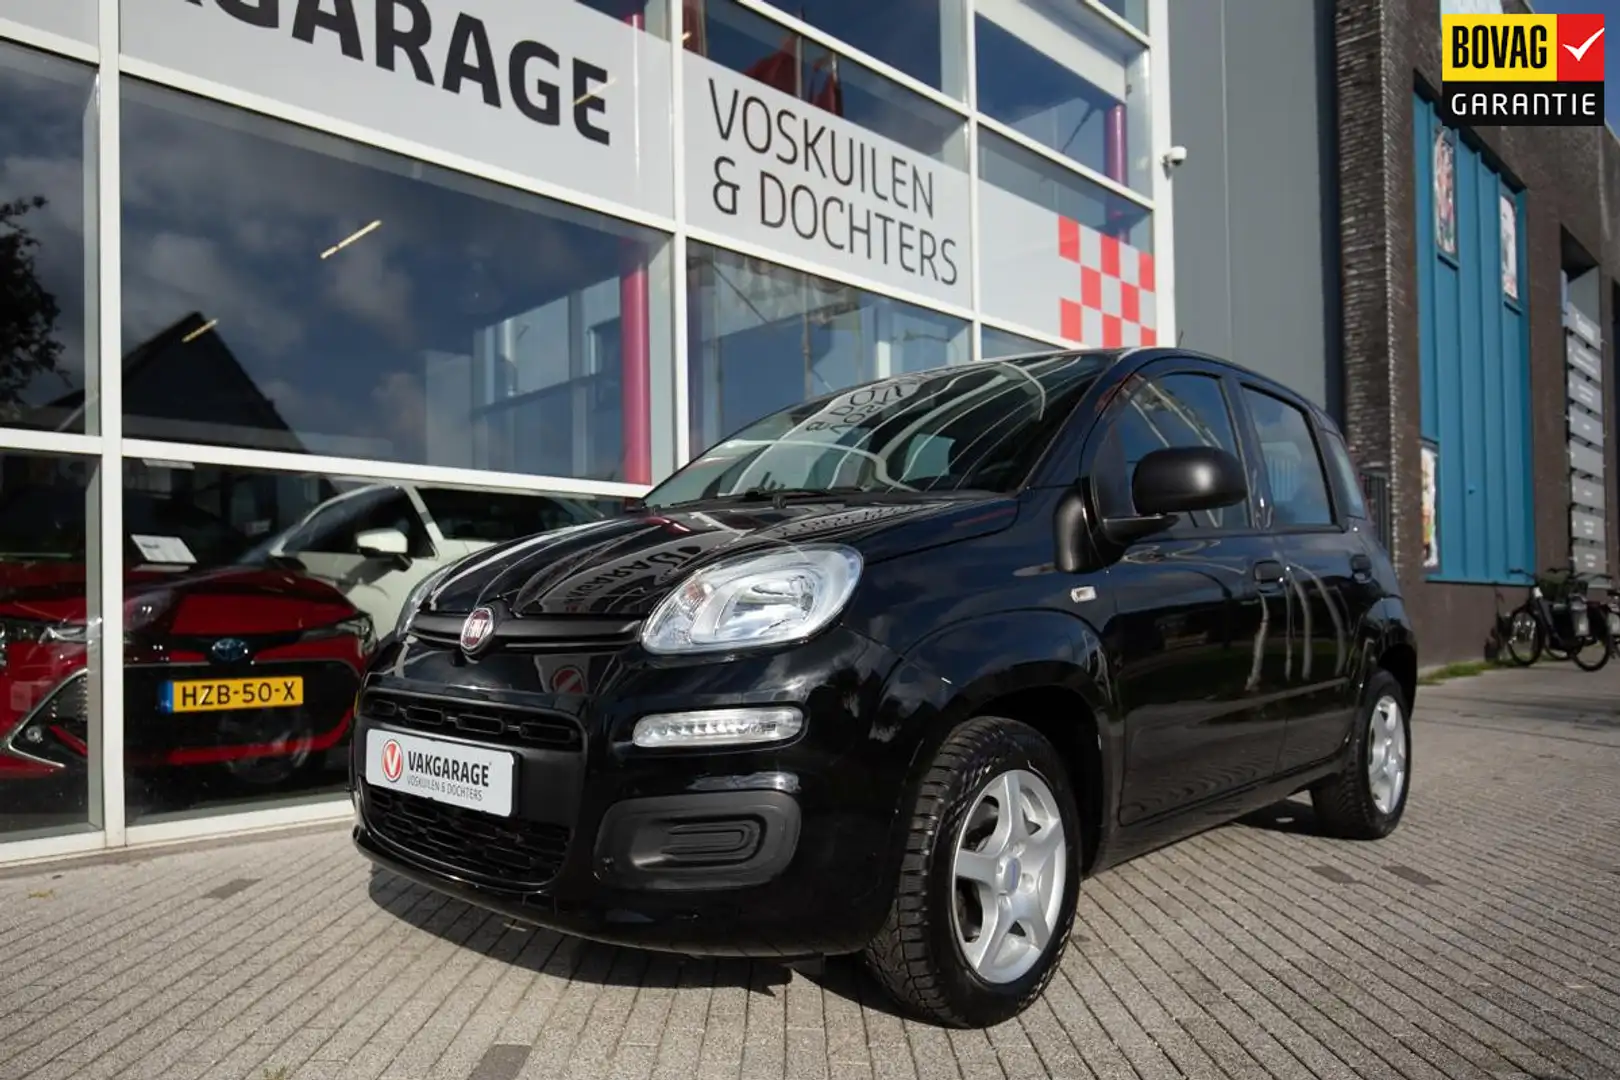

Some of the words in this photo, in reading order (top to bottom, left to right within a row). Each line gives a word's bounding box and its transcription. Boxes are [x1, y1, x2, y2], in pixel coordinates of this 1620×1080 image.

[708, 78, 935, 219] VOSKUILEN
[713, 156, 740, 215] &
[760, 170, 958, 286] DOCHTERS
[181, 681, 296, 707] HZB-50-X
[407, 750, 490, 788] VAKGARAGE
[446, 781, 483, 802] DOCHTERS
